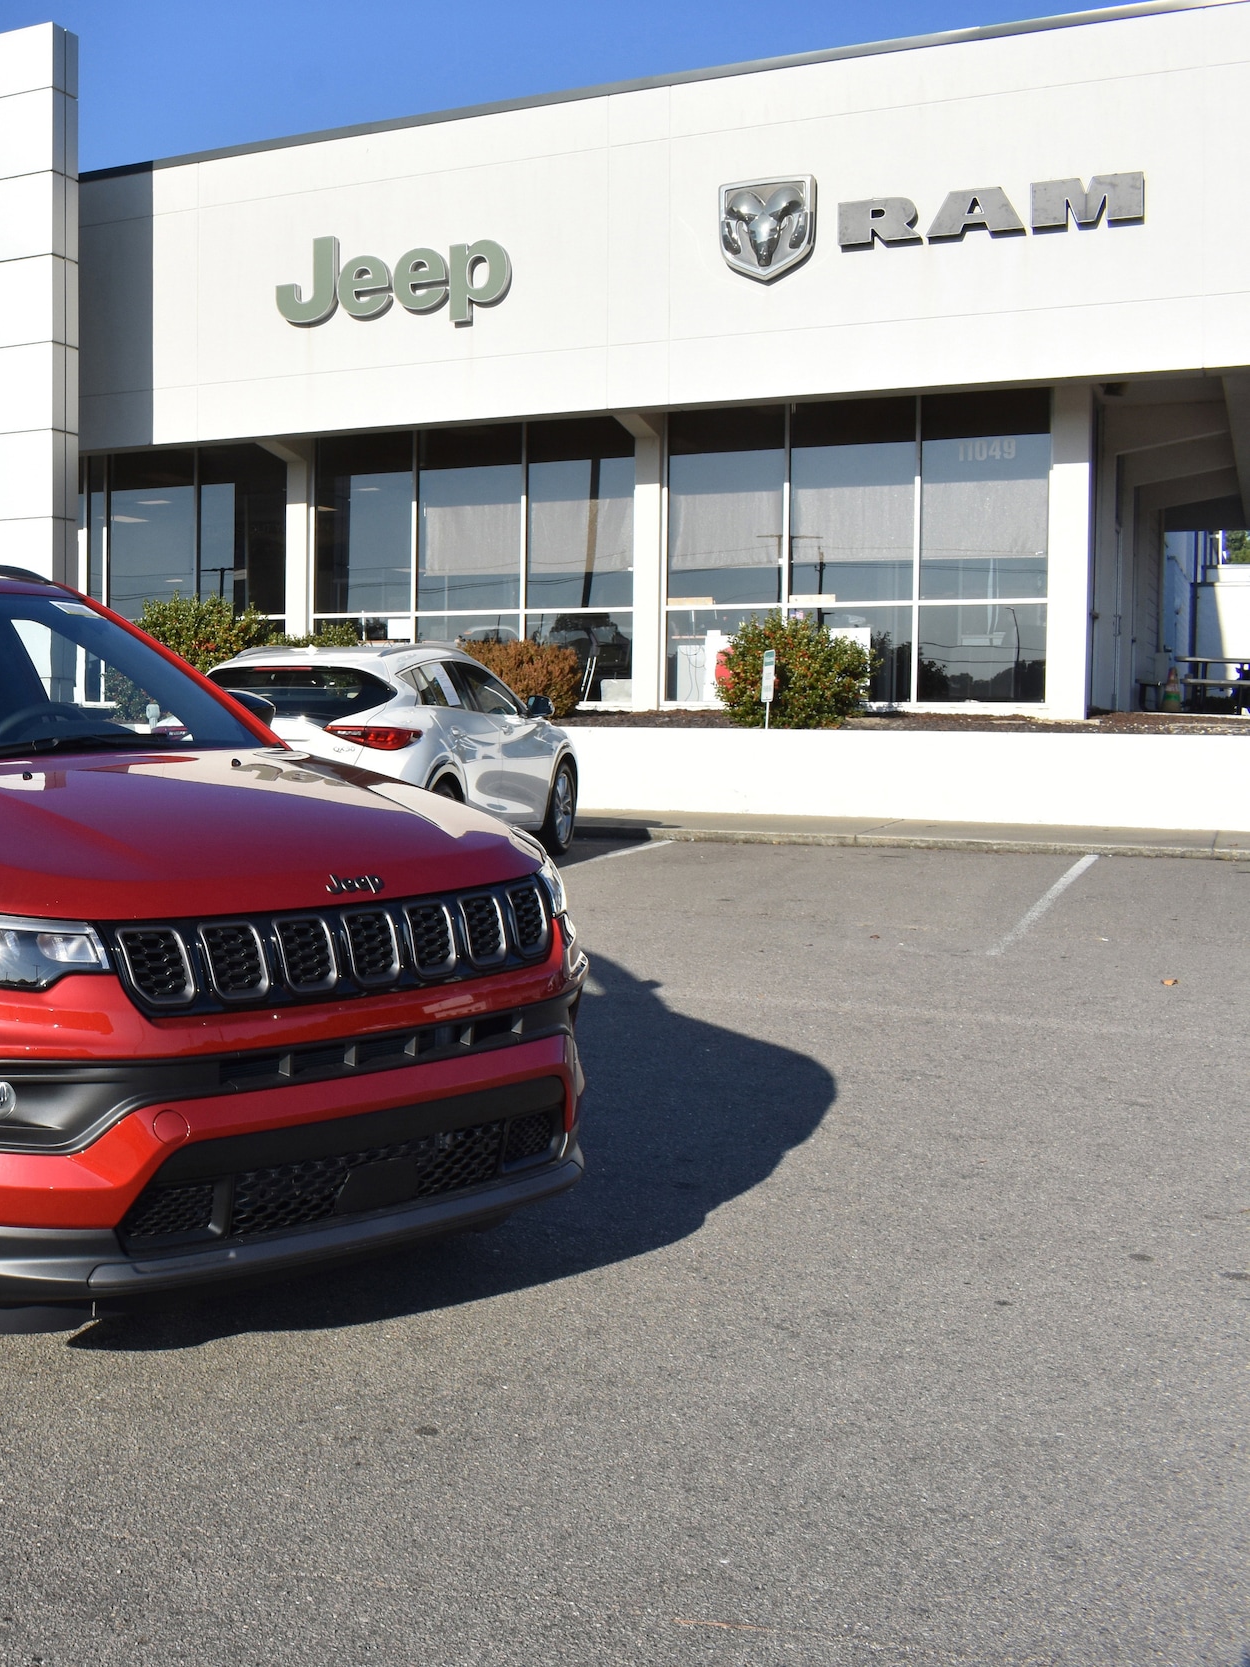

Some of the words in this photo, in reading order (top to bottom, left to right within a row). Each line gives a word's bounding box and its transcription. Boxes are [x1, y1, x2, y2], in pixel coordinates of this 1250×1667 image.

[837, 171, 1146, 253] RAM
[275, 235, 512, 328] Jeep
[958, 438, 1016, 462] 11049
[325, 873, 385, 895] Jeep
